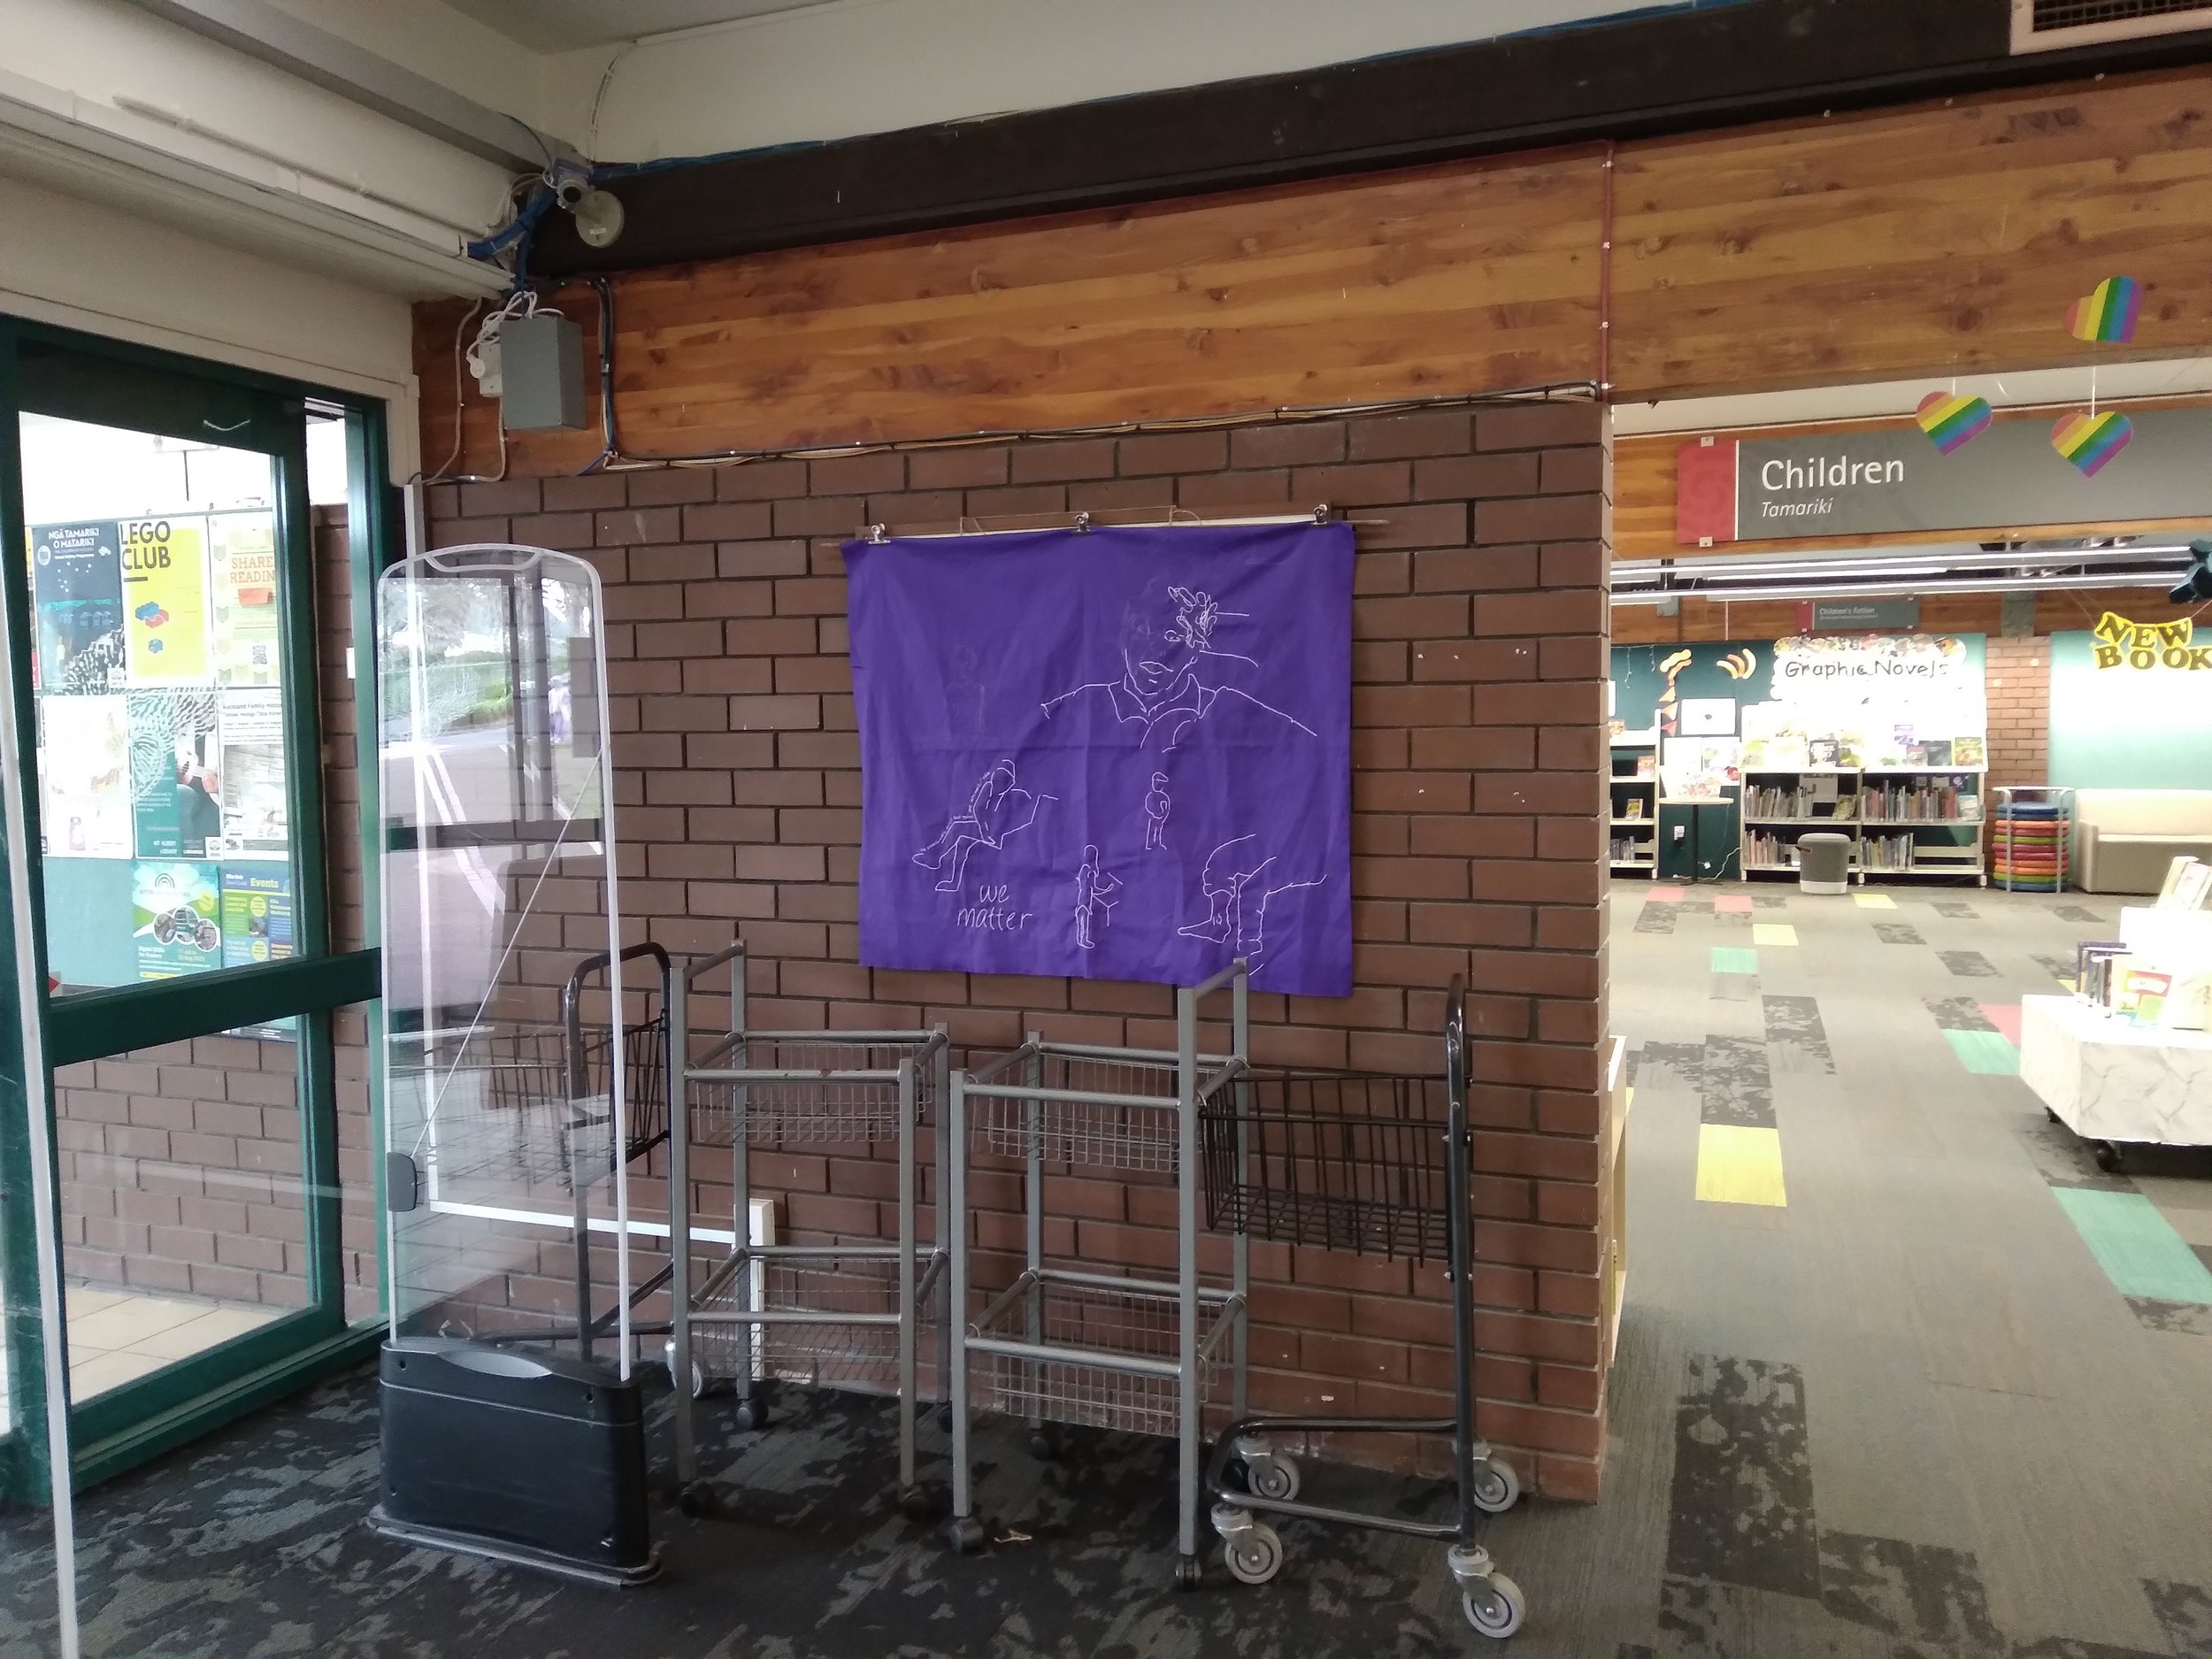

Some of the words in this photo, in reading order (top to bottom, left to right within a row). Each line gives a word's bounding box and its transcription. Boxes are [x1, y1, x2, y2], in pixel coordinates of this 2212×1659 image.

[1761, 455, 1904, 491] Children
[1762, 497, 1834, 518] Tamariki
[48, 528, 65, 540] NGĀ
[65, 527, 100, 539] TAMARIKI
[119, 520, 171, 545] LEGO
[53, 540, 60, 549] O
[60, 538, 95, 548] MATARIKI
[121, 546, 172, 571] CLUB
[231, 556, 274, 569] SHARE
[1819, 607, 1852, 616] Children's
[2095, 613, 2190, 648] NEW
[2094, 646, 2212, 671] BOOK
[1785, 661, 1868, 680] Graphic
[1874, 659, 1948, 679] Novels
[250, 877, 279, 888] Events
[979, 884, 1010, 903] we
[956, 906, 1033, 931] matter
